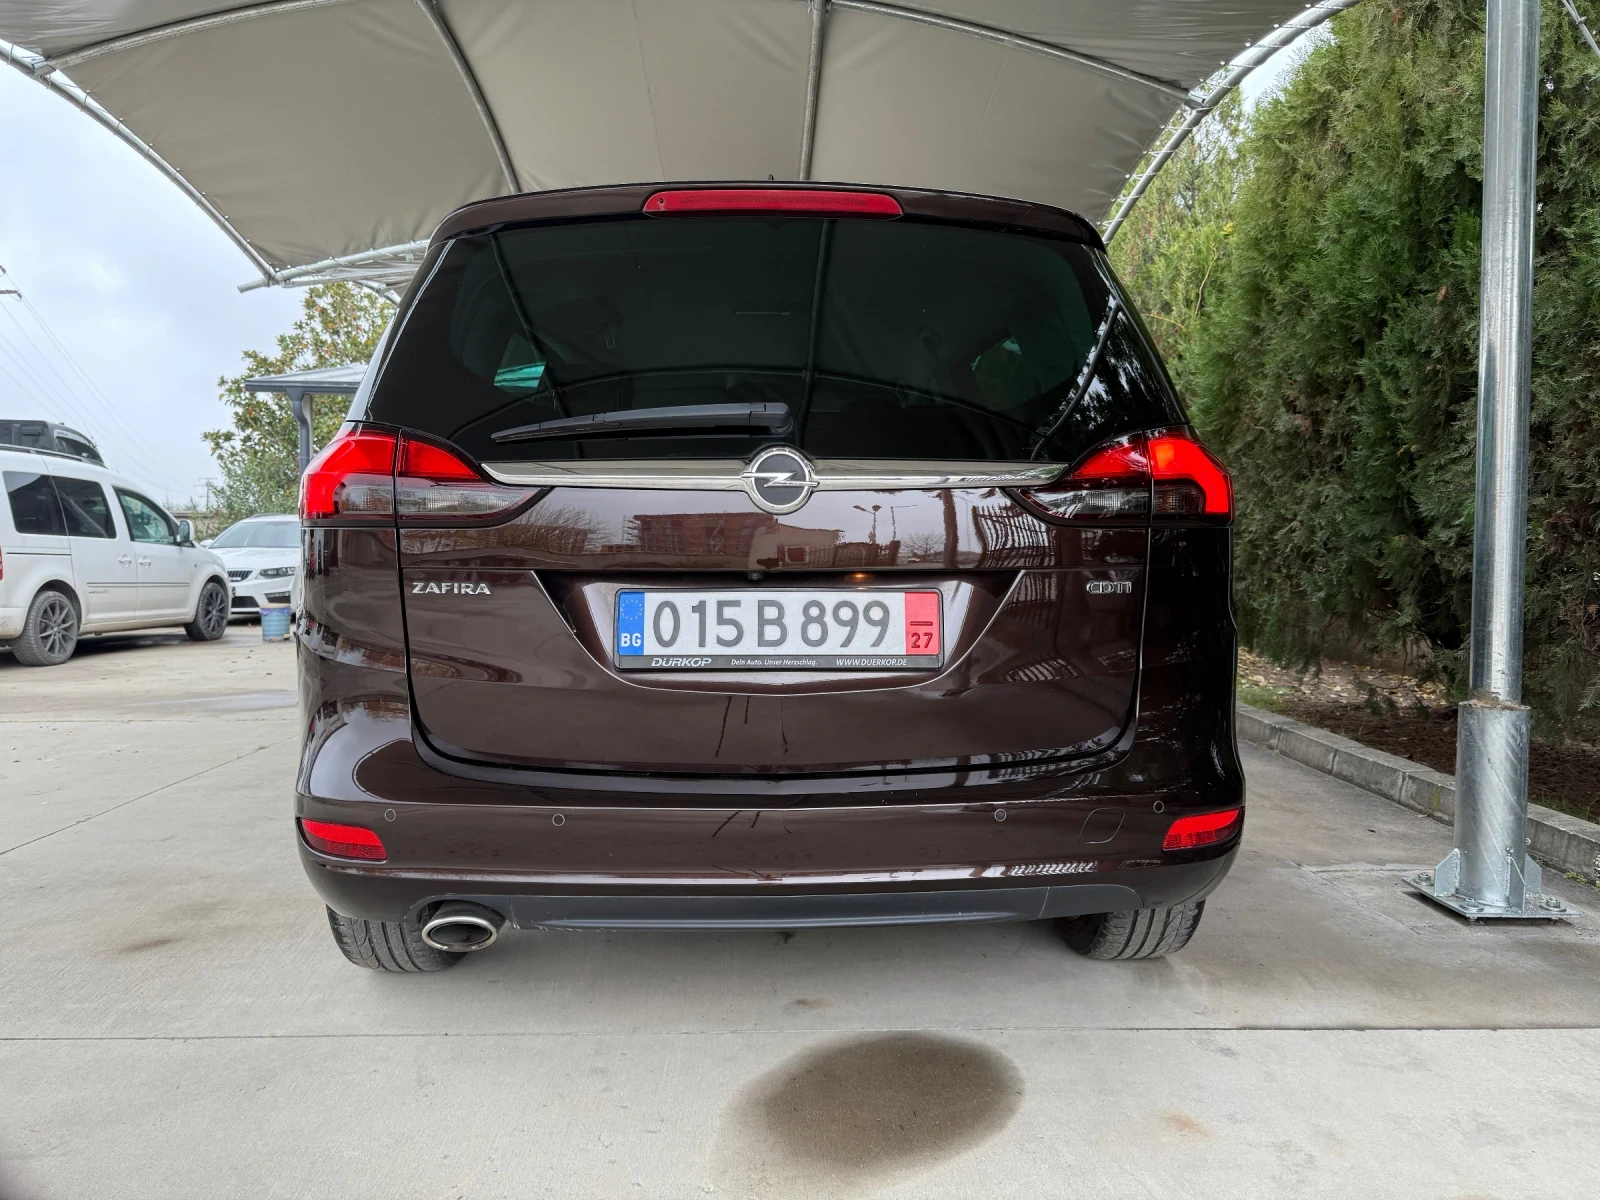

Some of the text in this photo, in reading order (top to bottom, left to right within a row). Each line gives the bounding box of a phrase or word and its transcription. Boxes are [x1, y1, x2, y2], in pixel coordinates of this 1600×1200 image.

[412, 582, 491, 595] ZAFIRA
[621, 632, 642, 648] BG
[910, 632, 934, 649] 27
[836, 658, 908, 667] WWW.DUERKOP.DE
